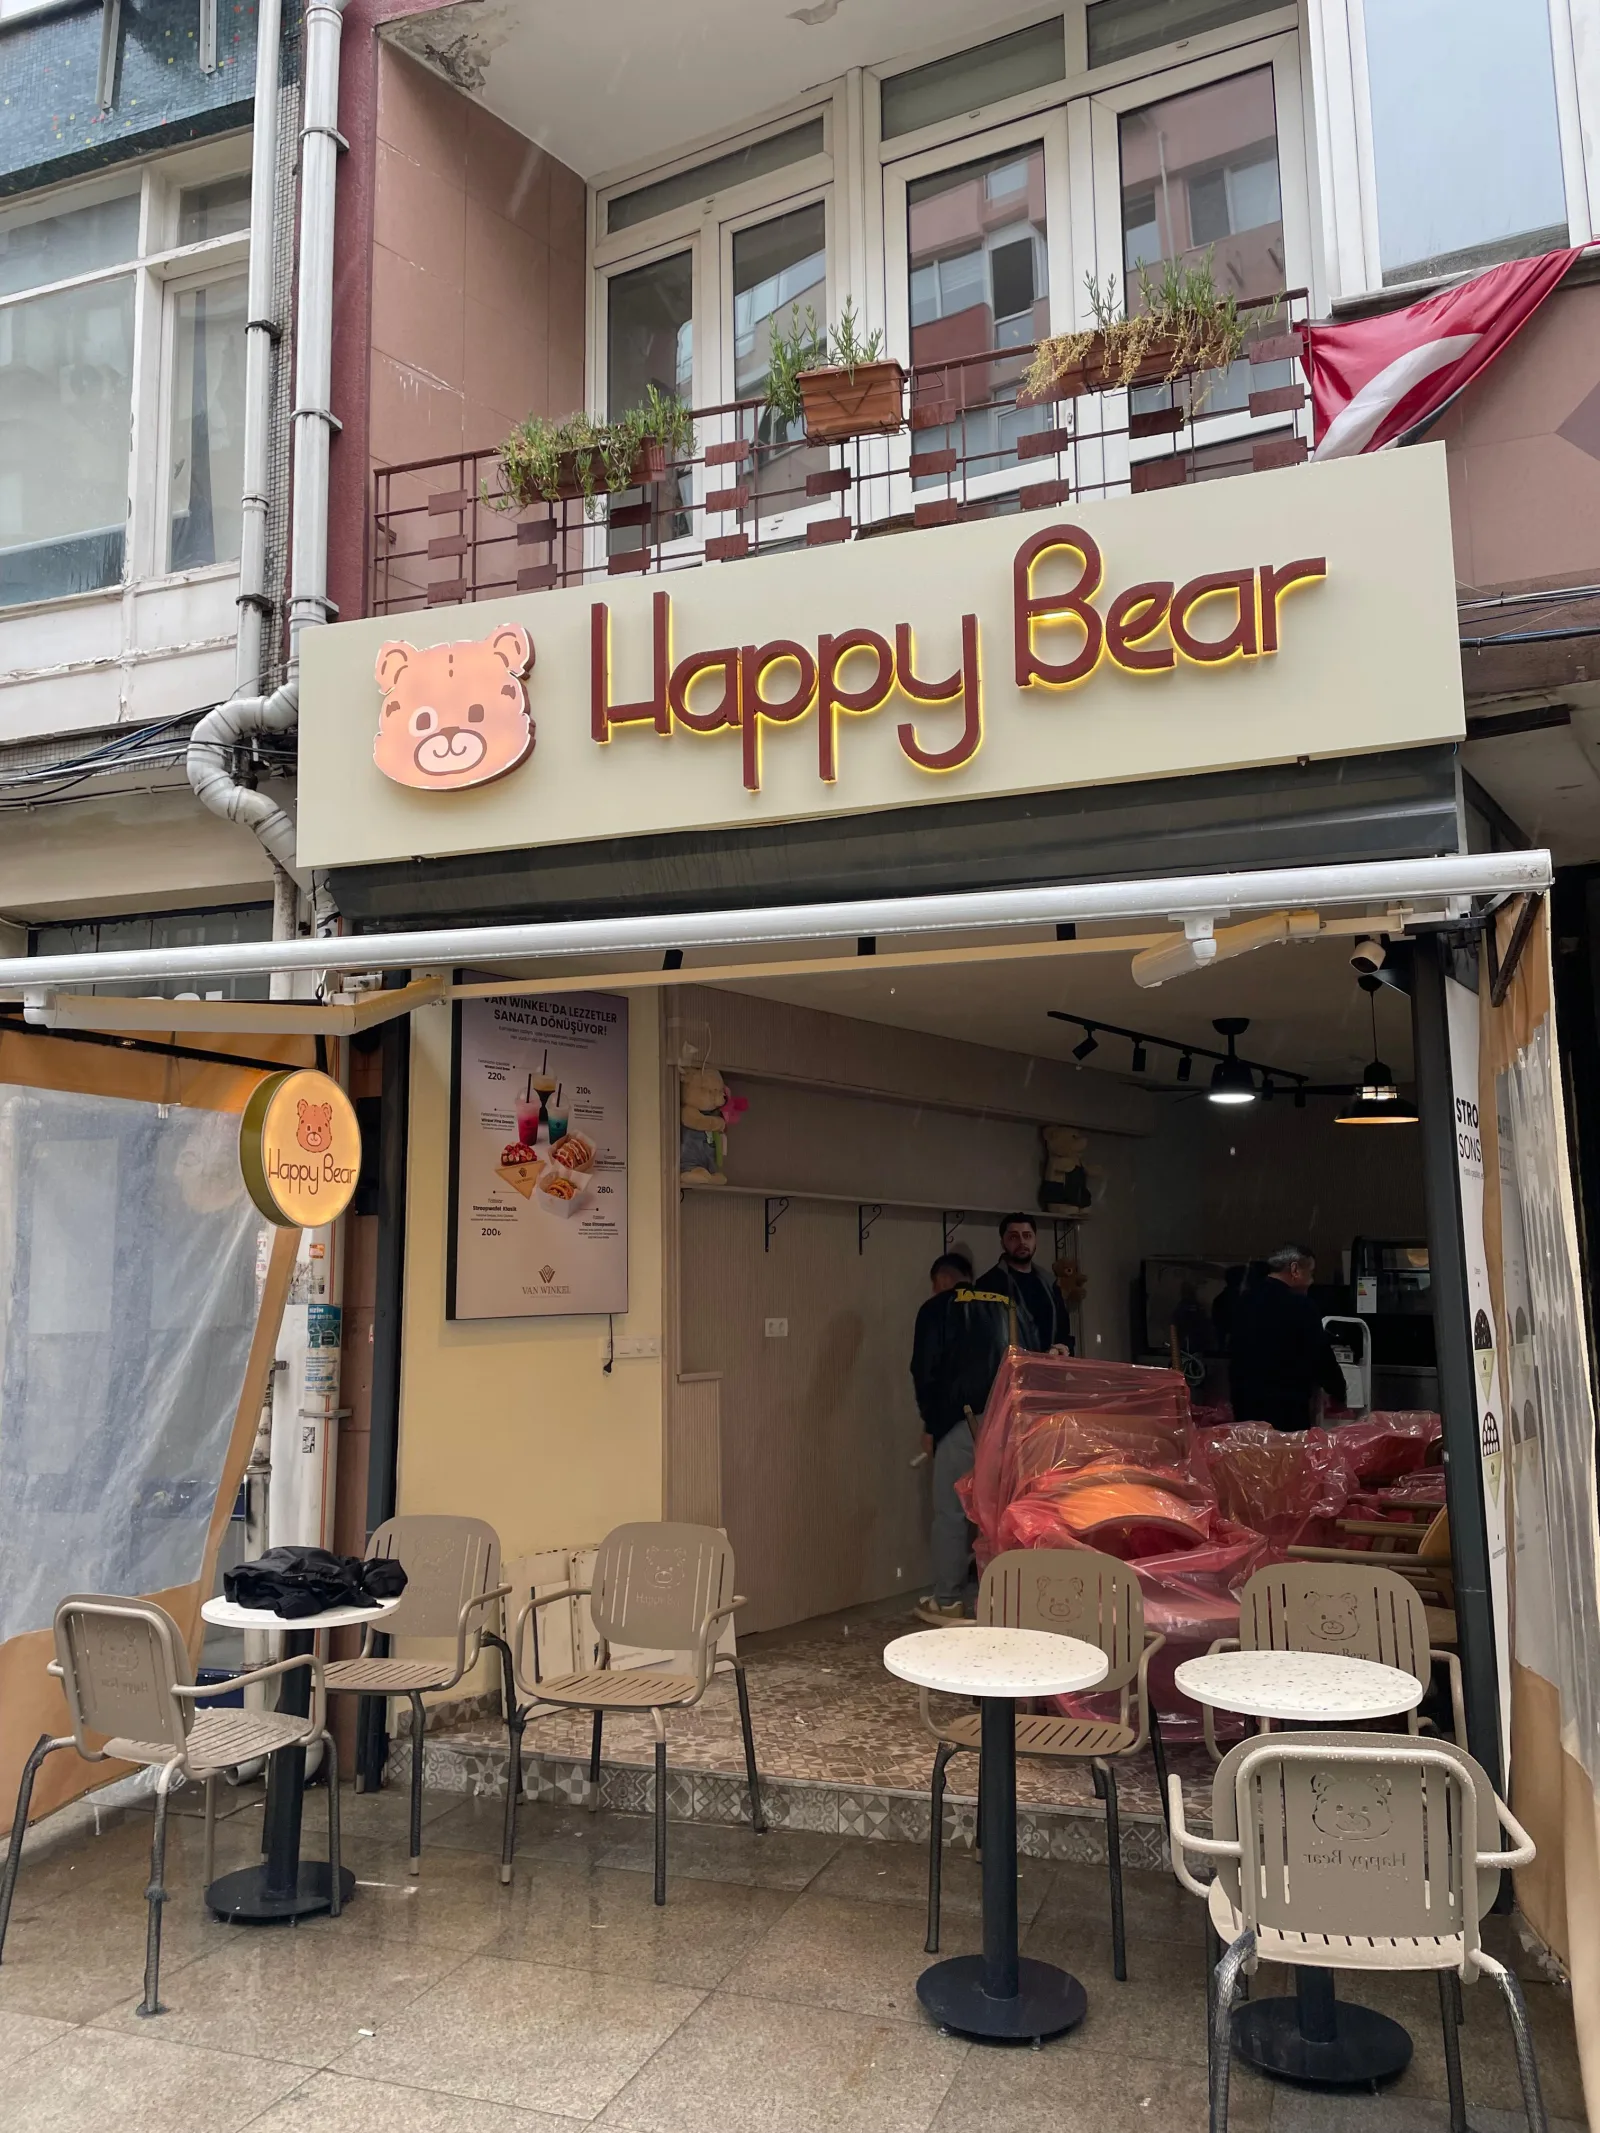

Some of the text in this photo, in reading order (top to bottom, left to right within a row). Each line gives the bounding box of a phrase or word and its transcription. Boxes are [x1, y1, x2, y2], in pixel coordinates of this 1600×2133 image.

[591, 524, 1328, 792] Happy Bear
[494, 1009, 538, 1026] SANATA
[540, 1015, 607, 1036] DÖNÜŞÜYOR!
[510, 996, 567, 1016] WINKEL'DA
[569, 1006, 617, 1024] LEZZETLER
[268, 1148, 357, 1195] Happy Bear
[522, 1285, 571, 1295] VAN WINKEL
